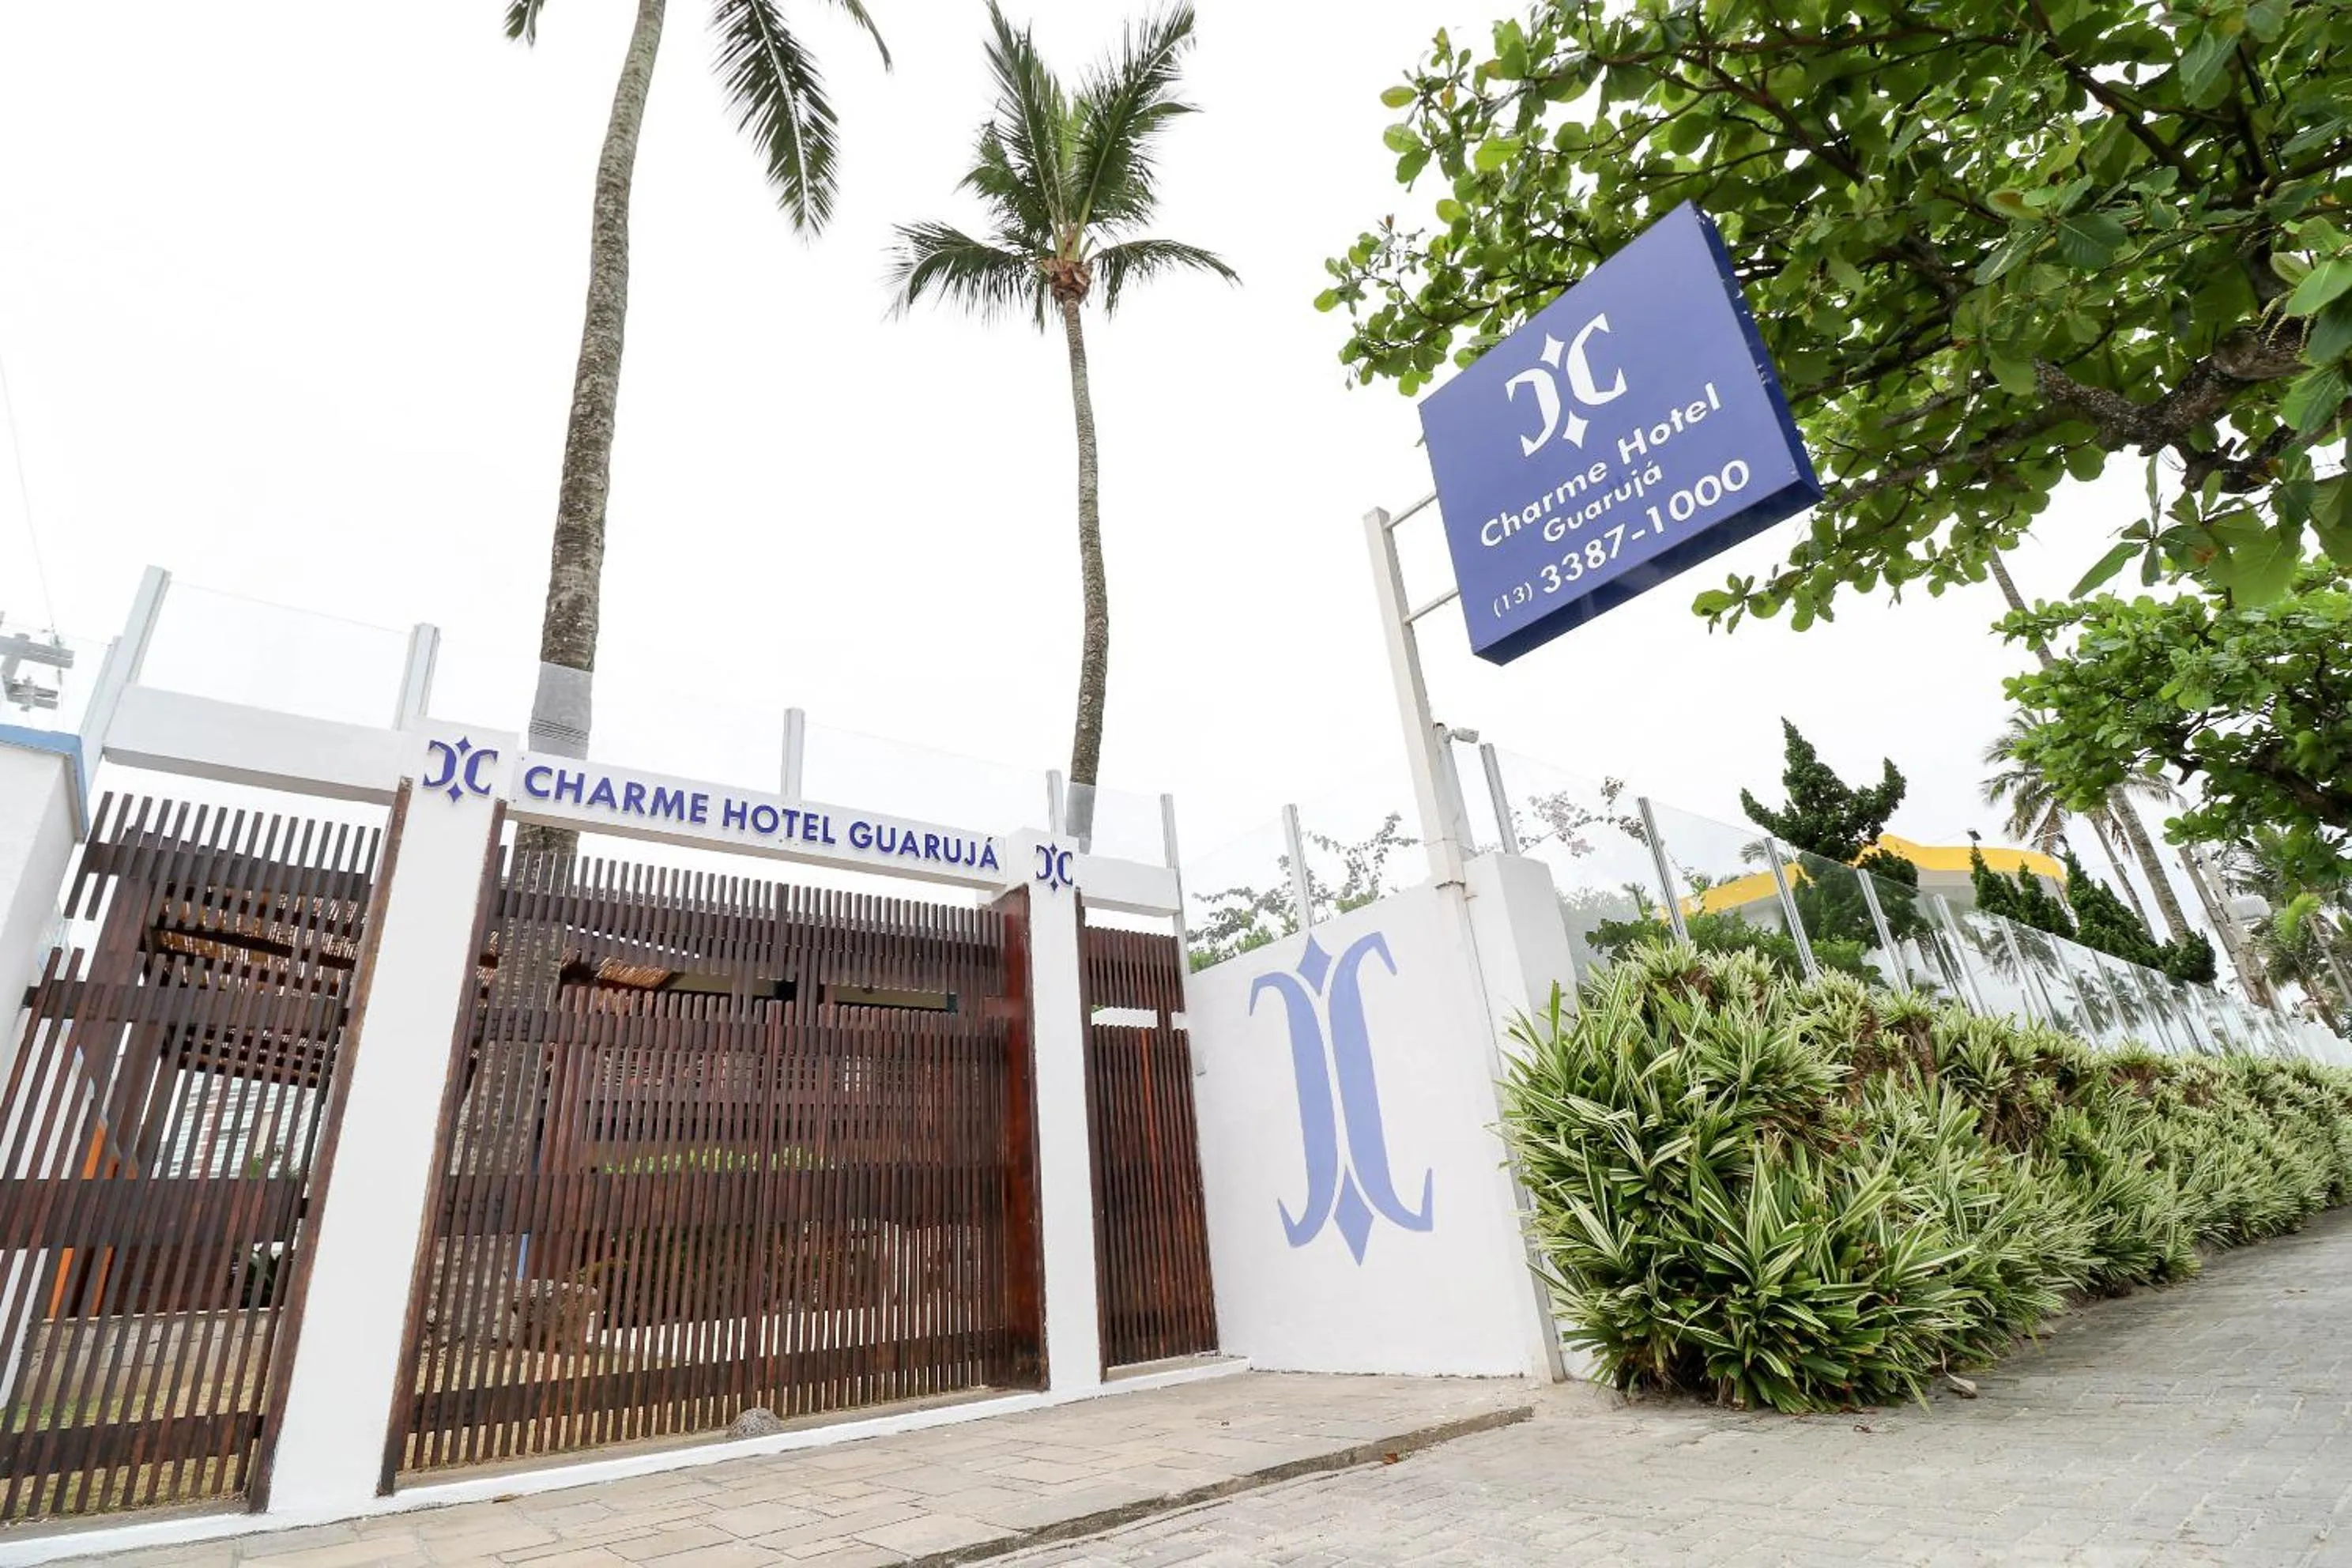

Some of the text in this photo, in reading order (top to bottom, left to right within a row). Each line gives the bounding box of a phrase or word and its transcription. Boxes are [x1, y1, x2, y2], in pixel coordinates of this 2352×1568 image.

[1479, 460, 1609, 548] Charme
[1617, 382, 1723, 466] Hotel
[1541, 462, 1664, 544] Guarujá
[1492, 459, 1751, 619] (13) 3387-1000
[524, 764, 710, 824] CHARME
[722, 797, 836, 845] HOTEL
[848, 820, 1001, 870] GUARUJÁ
